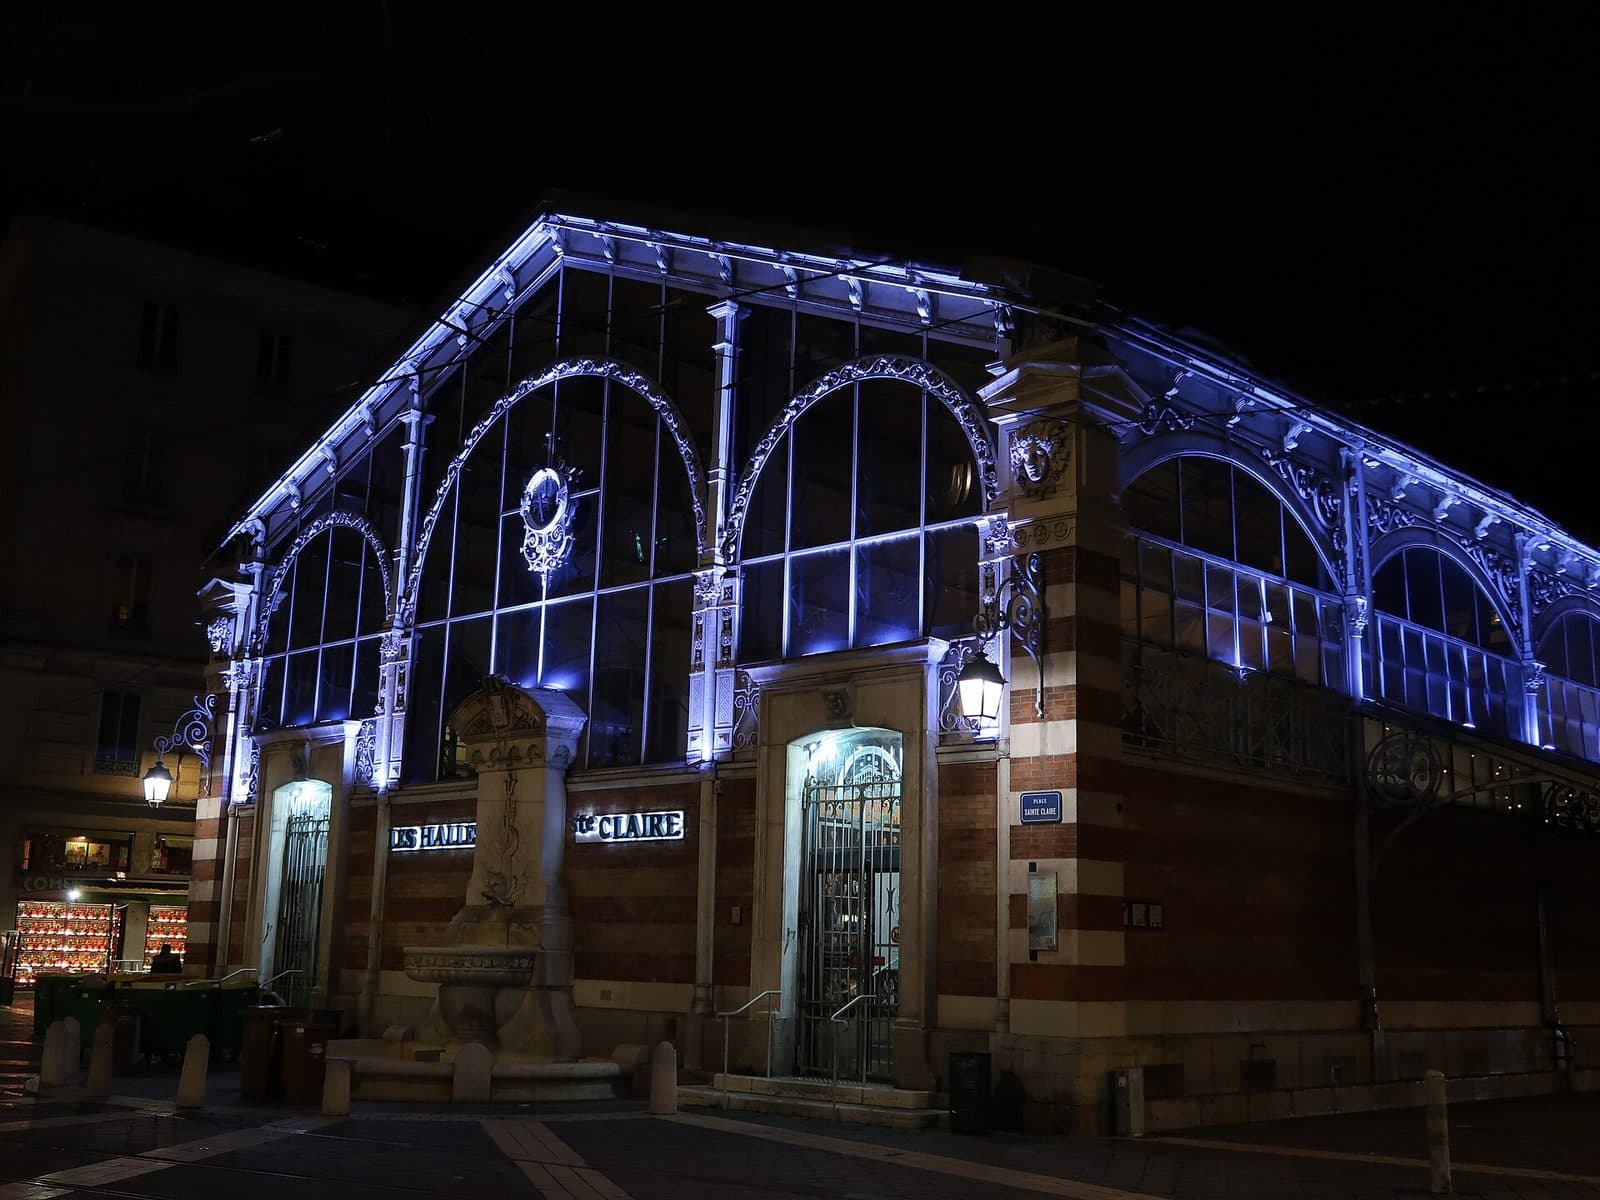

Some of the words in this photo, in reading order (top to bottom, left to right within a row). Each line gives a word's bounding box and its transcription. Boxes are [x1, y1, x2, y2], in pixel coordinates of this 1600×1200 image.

[1024, 808, 1040, 816] SAINTE
[1040, 807, 1057, 816] CLAIRE
[599, 813, 682, 839] CLAIRE
